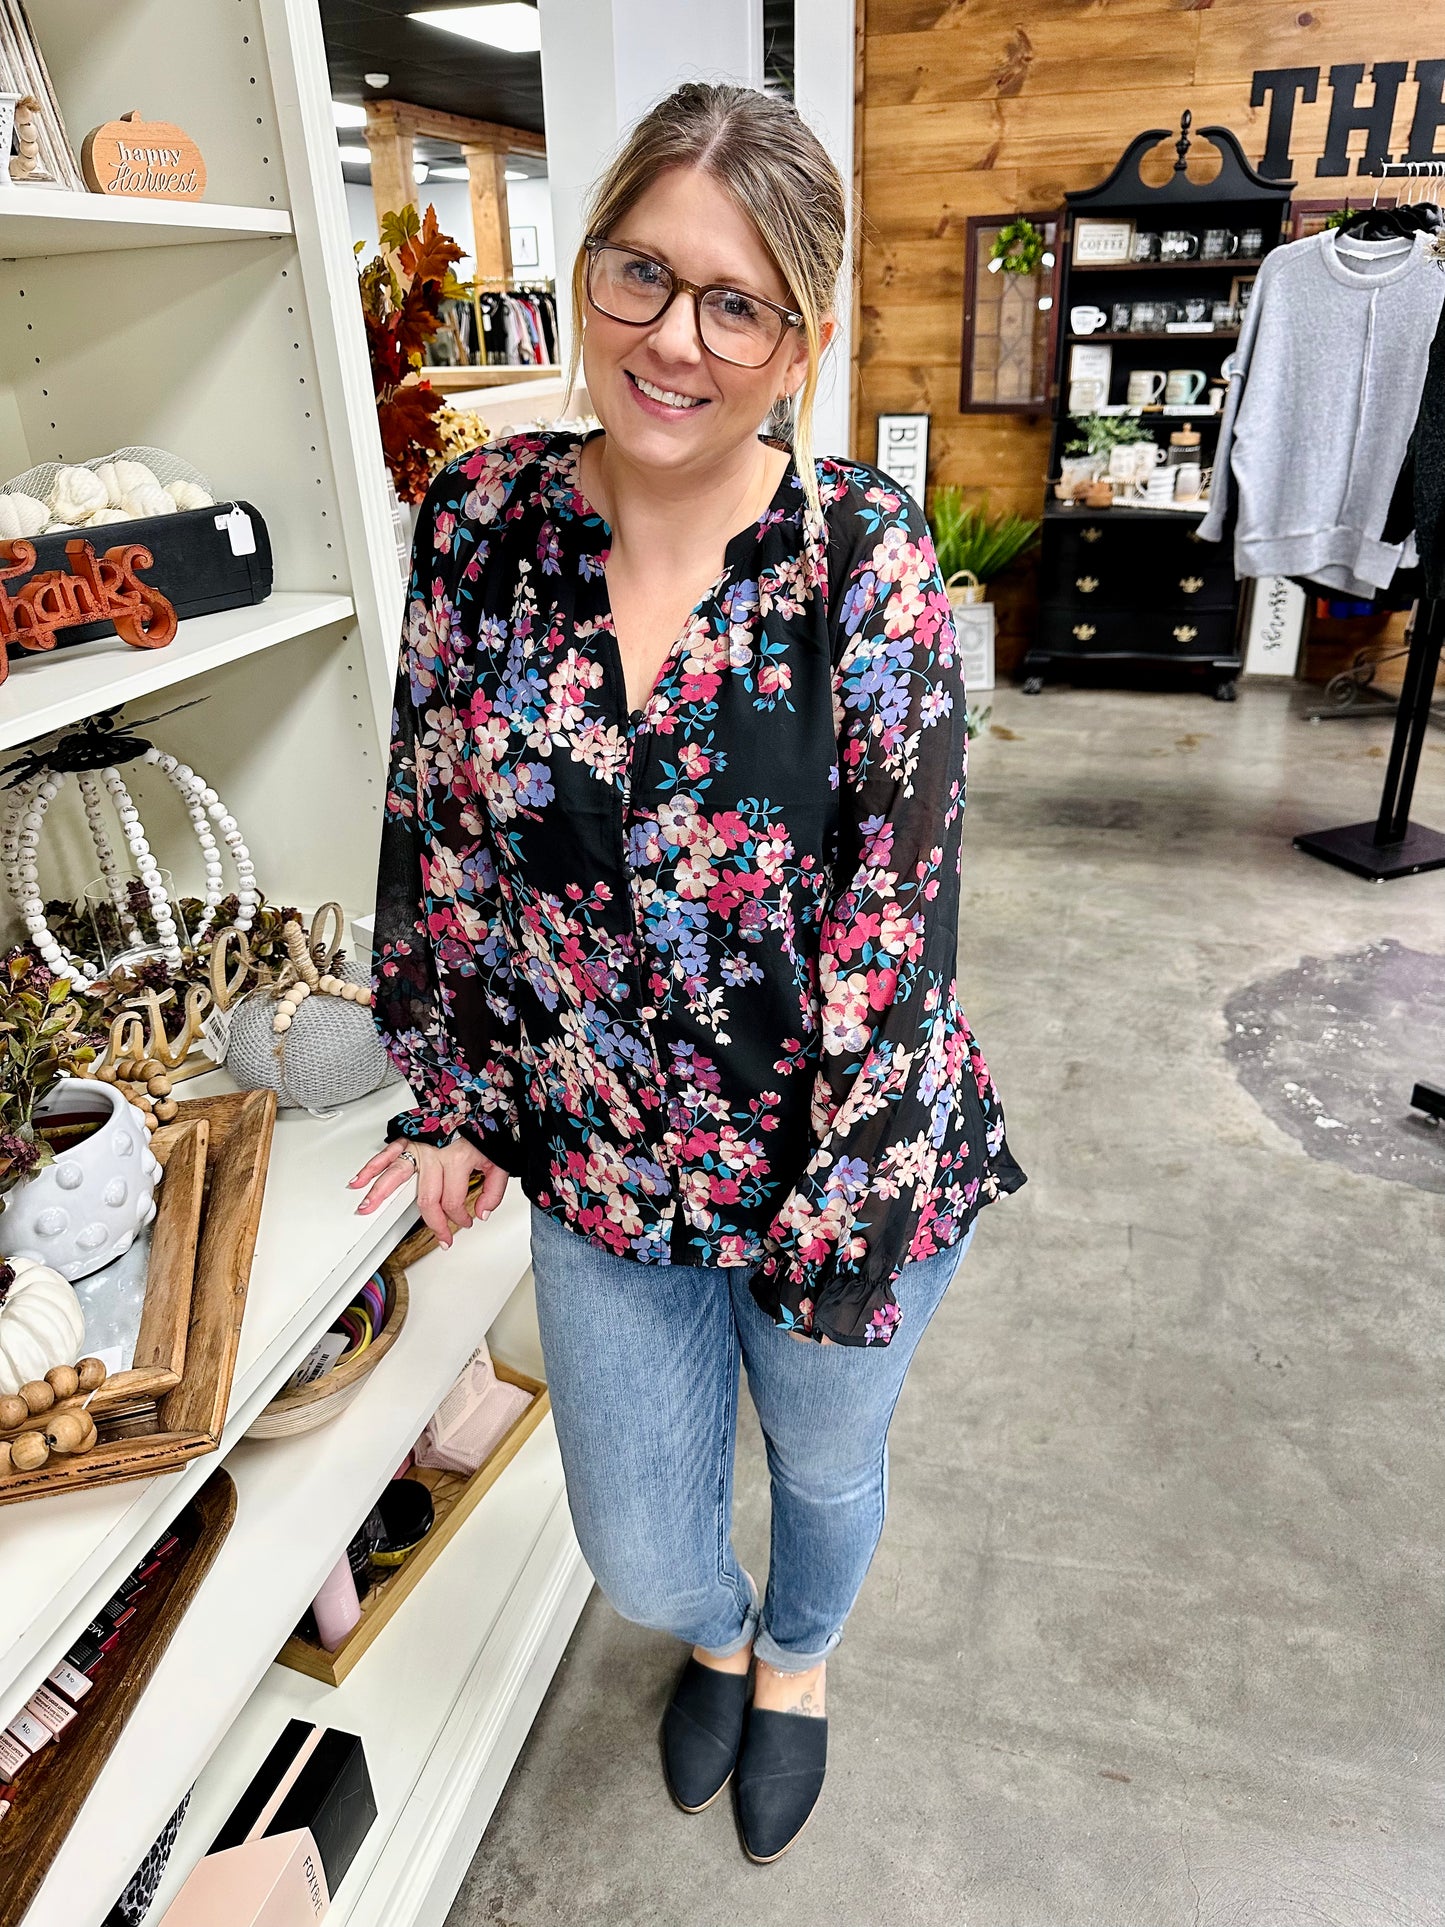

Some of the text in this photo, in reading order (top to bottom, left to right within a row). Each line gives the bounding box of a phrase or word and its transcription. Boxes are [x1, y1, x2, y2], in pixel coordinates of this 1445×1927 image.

[116, 141, 182, 167] happy
[108, 162, 198, 192] Harvest
[1080, 240, 1127, 250] COFFEE
